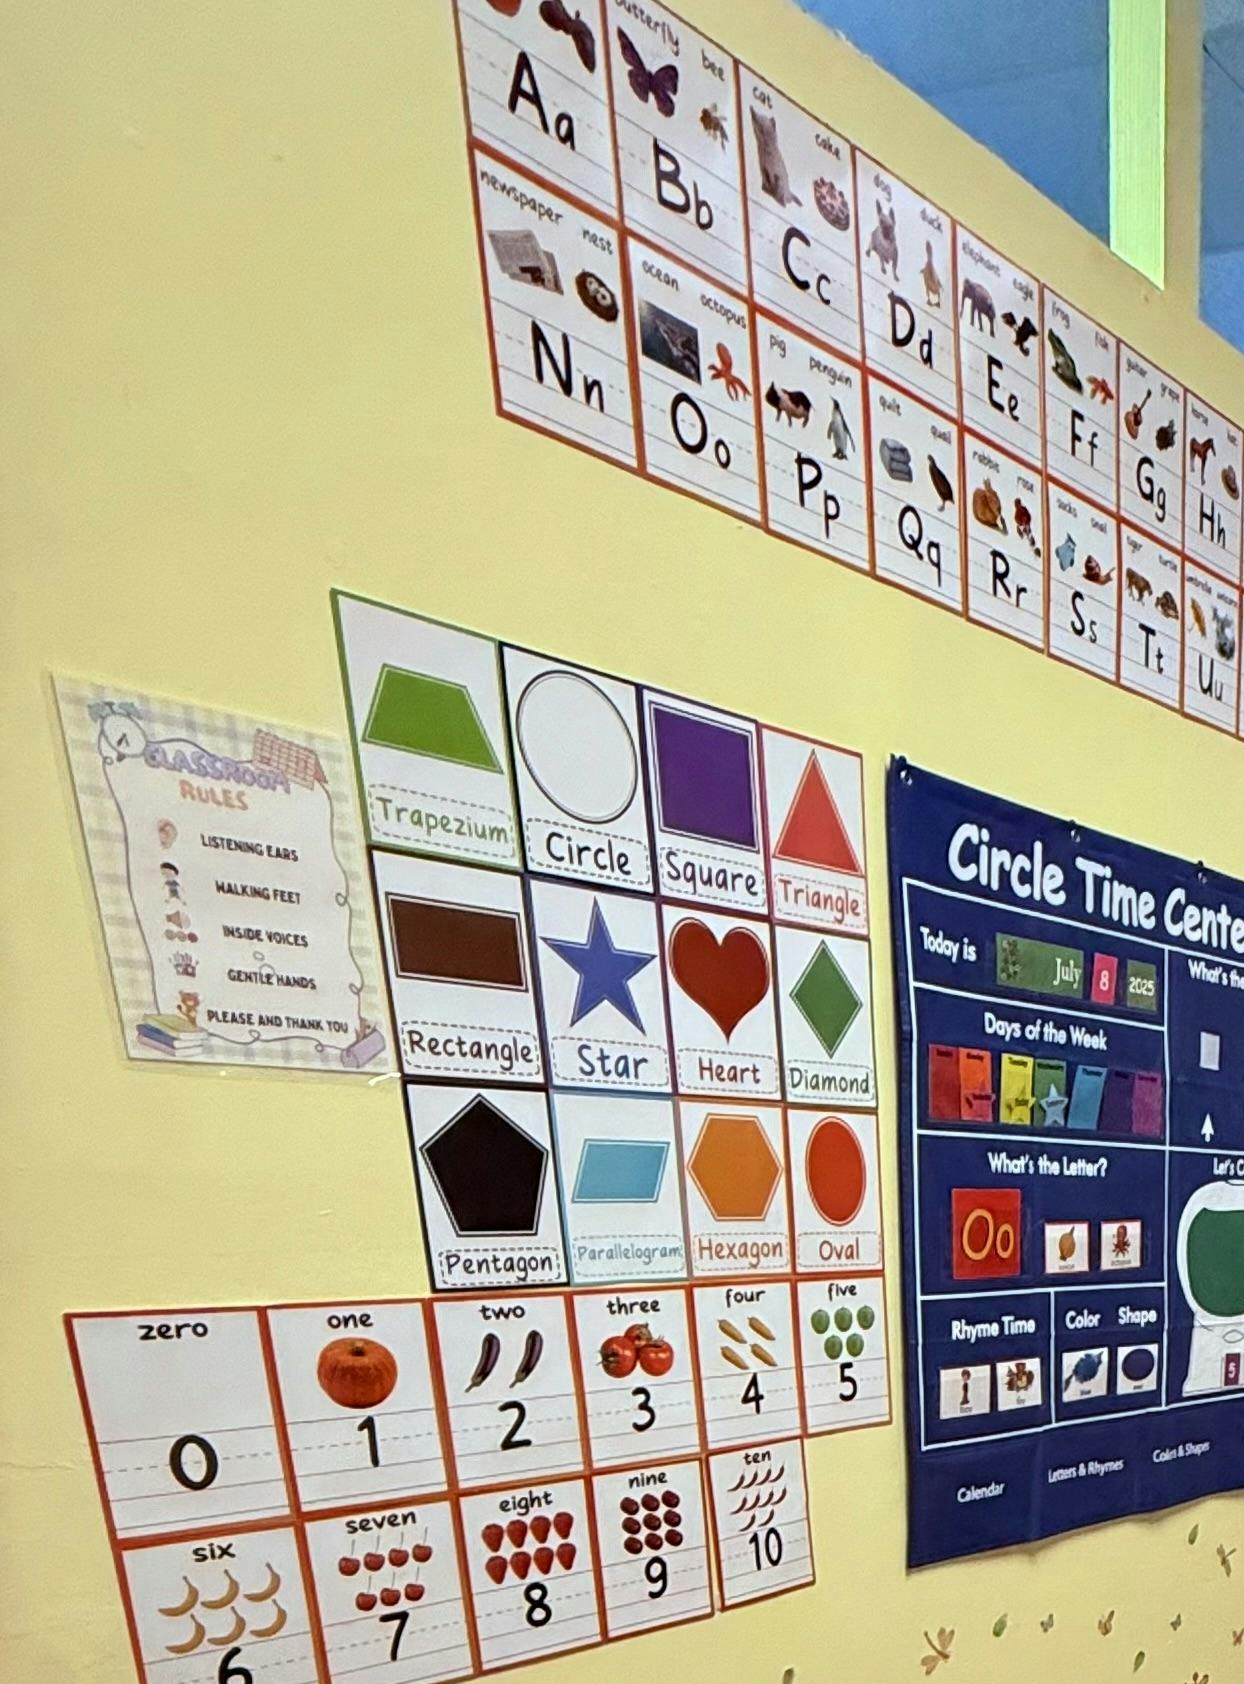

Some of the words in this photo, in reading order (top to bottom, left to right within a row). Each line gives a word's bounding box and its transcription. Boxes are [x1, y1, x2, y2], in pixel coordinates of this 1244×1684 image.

[701, 48, 725, 82] bee
[508, 51, 577, 151] Aa
[752, 86, 773, 109] cat
[815, 133, 840, 160] cake
[480, 169, 564, 226] newspaper
[653, 137, 714, 231] Bb
[582, 227, 613, 255] nest
[641, 259, 679, 292] ocean
[781, 226, 833, 305] Cc
[700, 293, 747, 330] octopus
[769, 334, 787, 359] pig
[888, 291, 934, 370] Dd
[531, 319, 605, 413] Nn
[809, 355, 853, 388] penguin
[987, 355, 1020, 422] Ee
[670, 392, 732, 469] Oo
[1070, 409, 1099, 467] Ff
[795, 452, 840, 539] Pp
[1136, 456, 1167, 523] Gg
[1199, 492, 1227, 550] Hh
[899, 505, 942, 587] Qq
[990, 550, 1027, 607] Rr
[1070, 591, 1097, 643] Ss
[1138, 623, 1164, 674] Tt
[1198, 656, 1224, 701] Uu
[178, 779, 248, 811] RULES
[375, 795, 508, 844] Trapezium
[200, 833, 264, 856] LISTENING
[266, 845, 299, 862] EARS
[546, 832, 631, 876] Circle
[667, 850, 758, 897] Square
[948, 823, 1066, 905] Circle
[1075, 857, 1155, 929] Time
[215, 880, 270, 900] WALKING
[273, 889, 300, 905] FEET
[778, 878, 860, 923] Triangle
[222, 925, 264, 942] INSIDE
[266, 930, 308, 947] VOICES
[919, 926, 959, 963] Today
[963, 939, 977, 961] is
[227, 968, 273, 985] GENTLE
[276, 974, 316, 990] HANDS
[1053, 955, 1081, 988] July
[1099, 970, 1109, 991] 8
[1129, 977, 1154, 997] 2025
[1188, 959, 1228, 986] What's
[207, 1009, 255, 1025] PLEASE
[258, 1014, 282, 1027] AND
[285, 1016, 323, 1031] THANK
[326, 1020, 348, 1033] YOU
[984, 1012, 1022, 1040] Days
[1025, 1023, 1041, 1041] of
[1043, 1024, 1066, 1044] the
[1069, 1028, 1107, 1051] Week
[409, 1030, 533, 1071] Rectangle
[577, 1046, 648, 1079] Star
[699, 1058, 760, 1084] Heart
[789, 1068, 870, 1095] Diamond
[987, 1152, 1034, 1175] What's
[1038, 1156, 1060, 1175] the
[1063, 1156, 1108, 1177] Letter?
[1213, 1158, 1234, 1175] Let's
[962, 1208, 1014, 1260] Oo
[445, 1253, 553, 1283] Pentagon
[578, 1243, 681, 1266] Parallelogram
[699, 1239, 784, 1269] Hexagon
[819, 1243, 860, 1263] Oval
[606, 1294, 662, 1317] three
[724, 1287, 766, 1305] four
[826, 1280, 858, 1301] five
[326, 1311, 374, 1331] one
[478, 1301, 525, 1321] two
[1065, 1309, 1101, 1329] Color
[1118, 1305, 1157, 1327] Shape
[137, 1317, 209, 1342] zero
[951, 1319, 999, 1343] Rhyme
[1001, 1315, 1035, 1335] Time
[838, 1361, 858, 1402] 5
[1228, 1363, 1236, 1378] 5
[631, 1386, 656, 1433] 3
[740, 1371, 765, 1416] 4
[356, 1415, 381, 1468] 1
[497, 1400, 532, 1451] 2
[168, 1434, 219, 1492] 0
[743, 1448, 772, 1466] ten
[1048, 1465, 1076, 1483] Letters
[1079, 1465, 1087, 1477] &
[1088, 1458, 1124, 1476] Rhymes
[628, 1470, 668, 1489] nine
[957, 1481, 1005, 1502] Calendar
[498, 1489, 553, 1517] eight
[345, 1509, 417, 1536] seven
[192, 1540, 236, 1563] six
[749, 1525, 784, 1571] 10
[644, 1555, 669, 1601] 9
[524, 1581, 552, 1628] 8
[378, 1611, 410, 1662] 7
